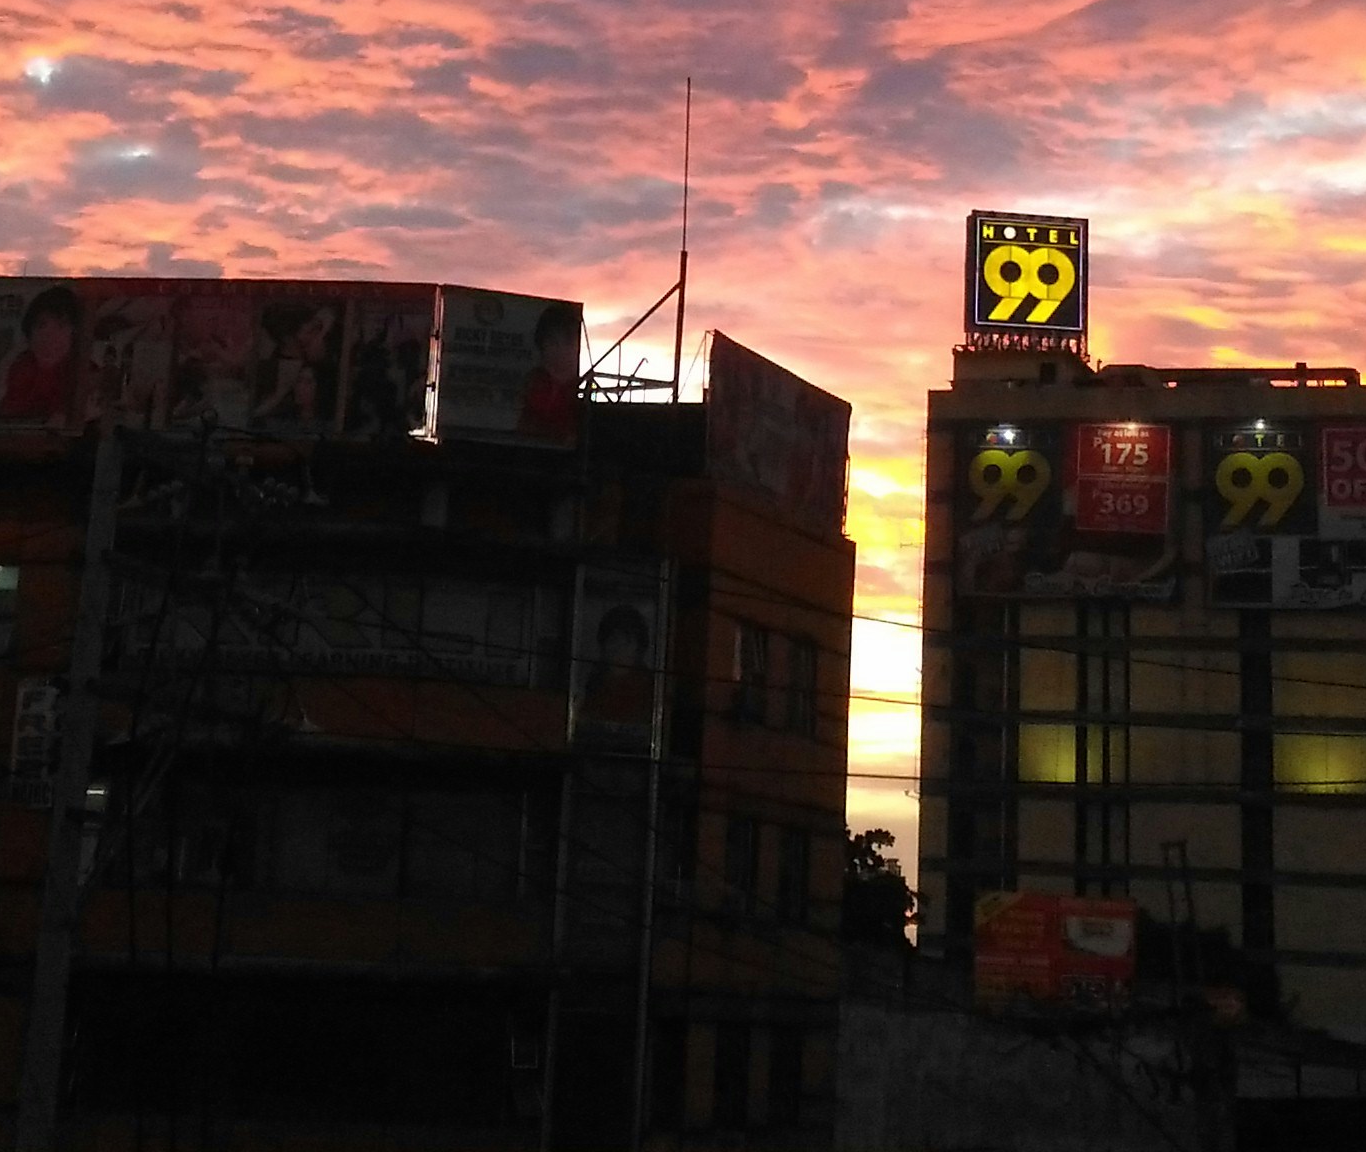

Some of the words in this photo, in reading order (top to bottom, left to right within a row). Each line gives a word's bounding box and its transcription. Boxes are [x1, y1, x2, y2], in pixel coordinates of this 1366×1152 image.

[982, 224, 1079, 245] HOTEL
[983, 245, 1076, 324] 99
[968, 449, 1052, 522] 99
[1215, 451, 1305, 534] 99
